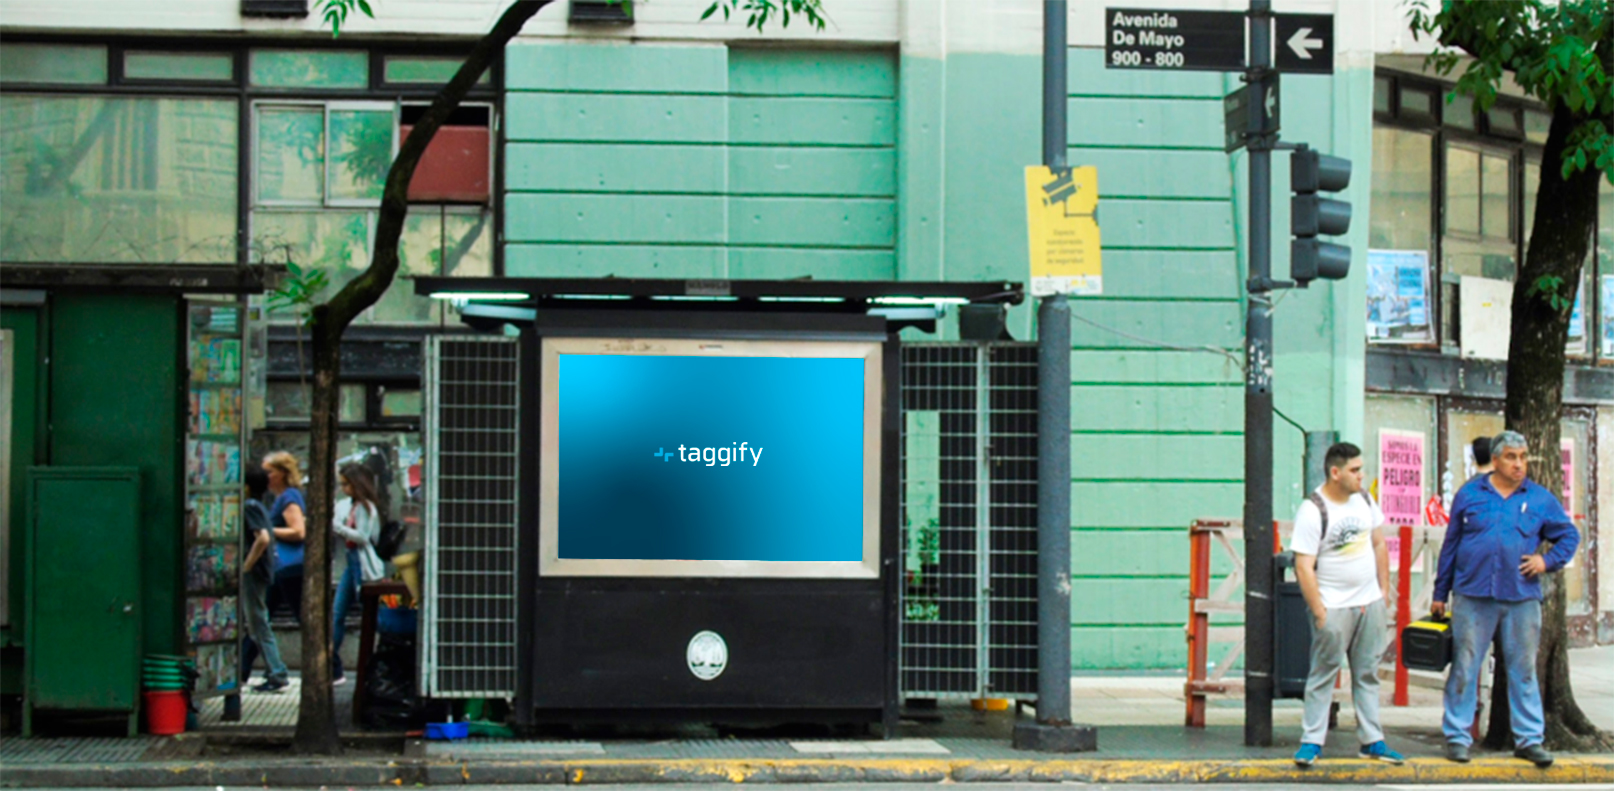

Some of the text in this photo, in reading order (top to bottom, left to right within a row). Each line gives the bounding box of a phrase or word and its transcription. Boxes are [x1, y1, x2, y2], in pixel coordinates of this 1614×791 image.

[1112, 11, 1178, 29] Avenida
[1112, 29, 1185, 50] De Mayo
[1112, 50, 1142, 66] 900
[1155, 51, 1185, 67] 800
[678, 441, 764, 467] taggify
[1382, 450, 1410, 465] ESPECIE
[1383, 467, 1420, 487] PELIGRO
